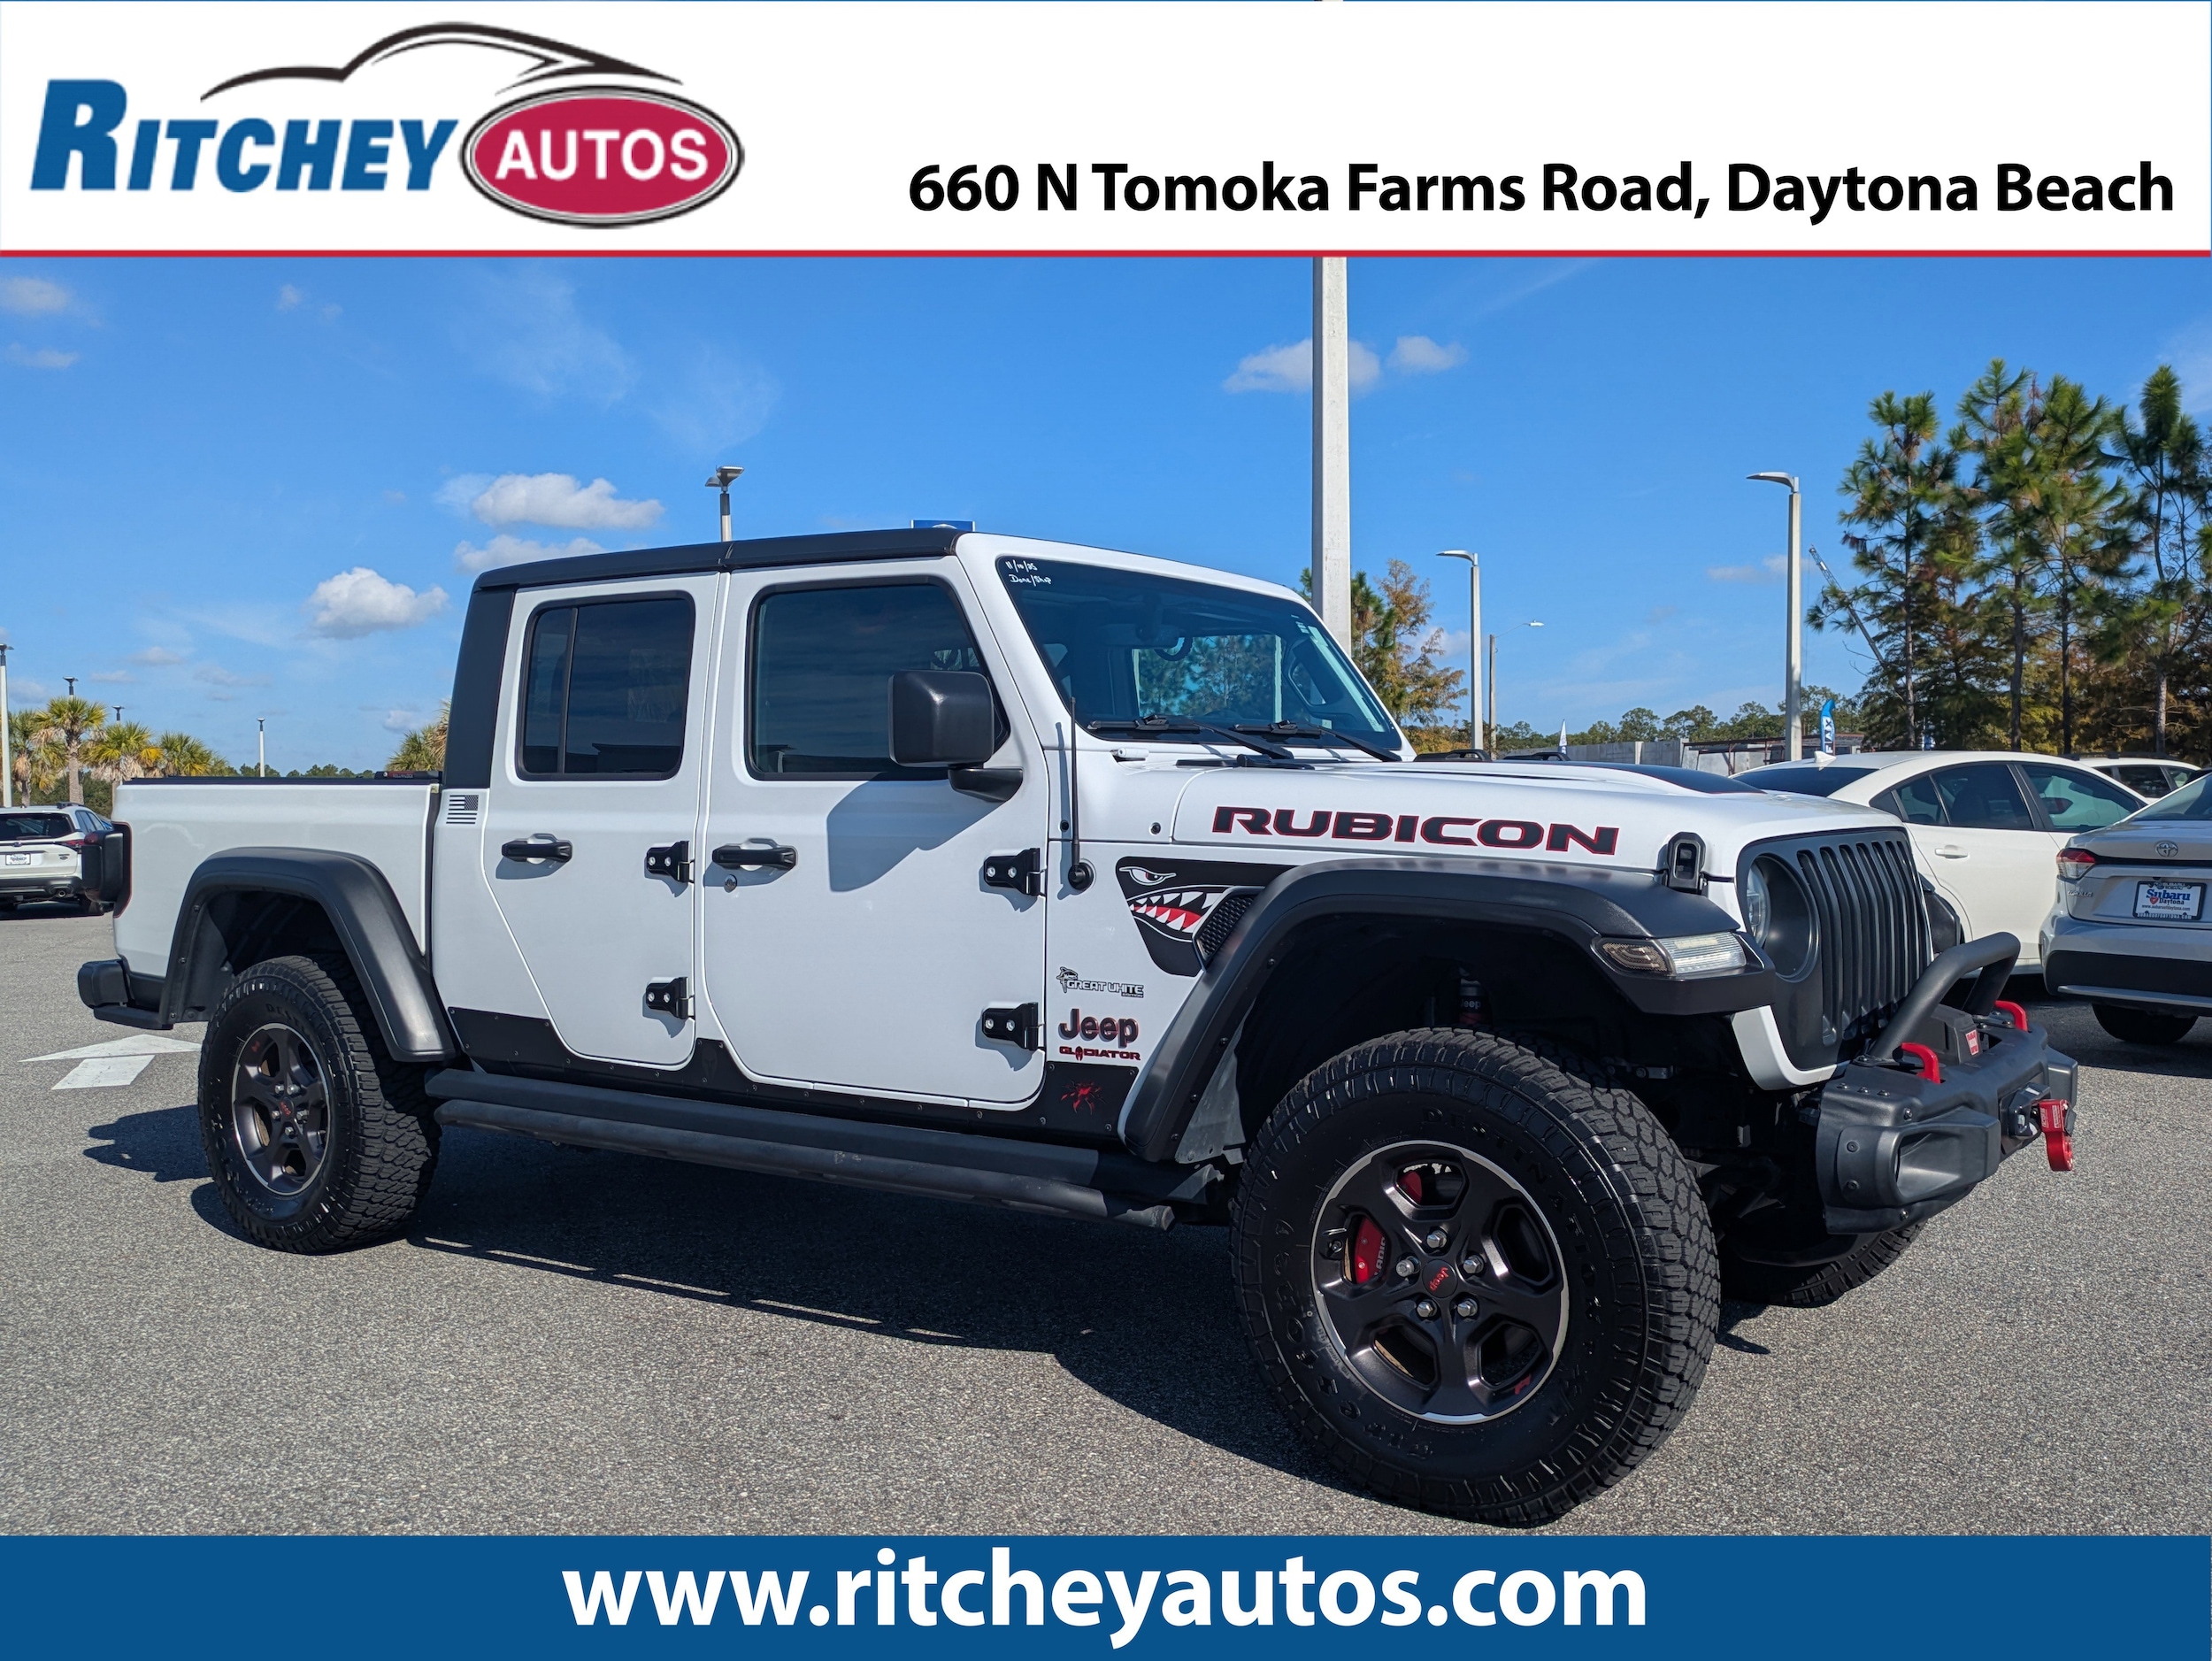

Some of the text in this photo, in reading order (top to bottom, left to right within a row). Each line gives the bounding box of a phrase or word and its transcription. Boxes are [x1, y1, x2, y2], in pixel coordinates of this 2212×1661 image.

[1211, 806, 1619, 856] RUBICON
[2147, 888, 2191, 901] Subaru
[1067, 980, 1144, 994] GREAT WHITE
[1058, 1008, 1139, 1049] Jeep
[1428, 1266, 1449, 1292] Jeep
